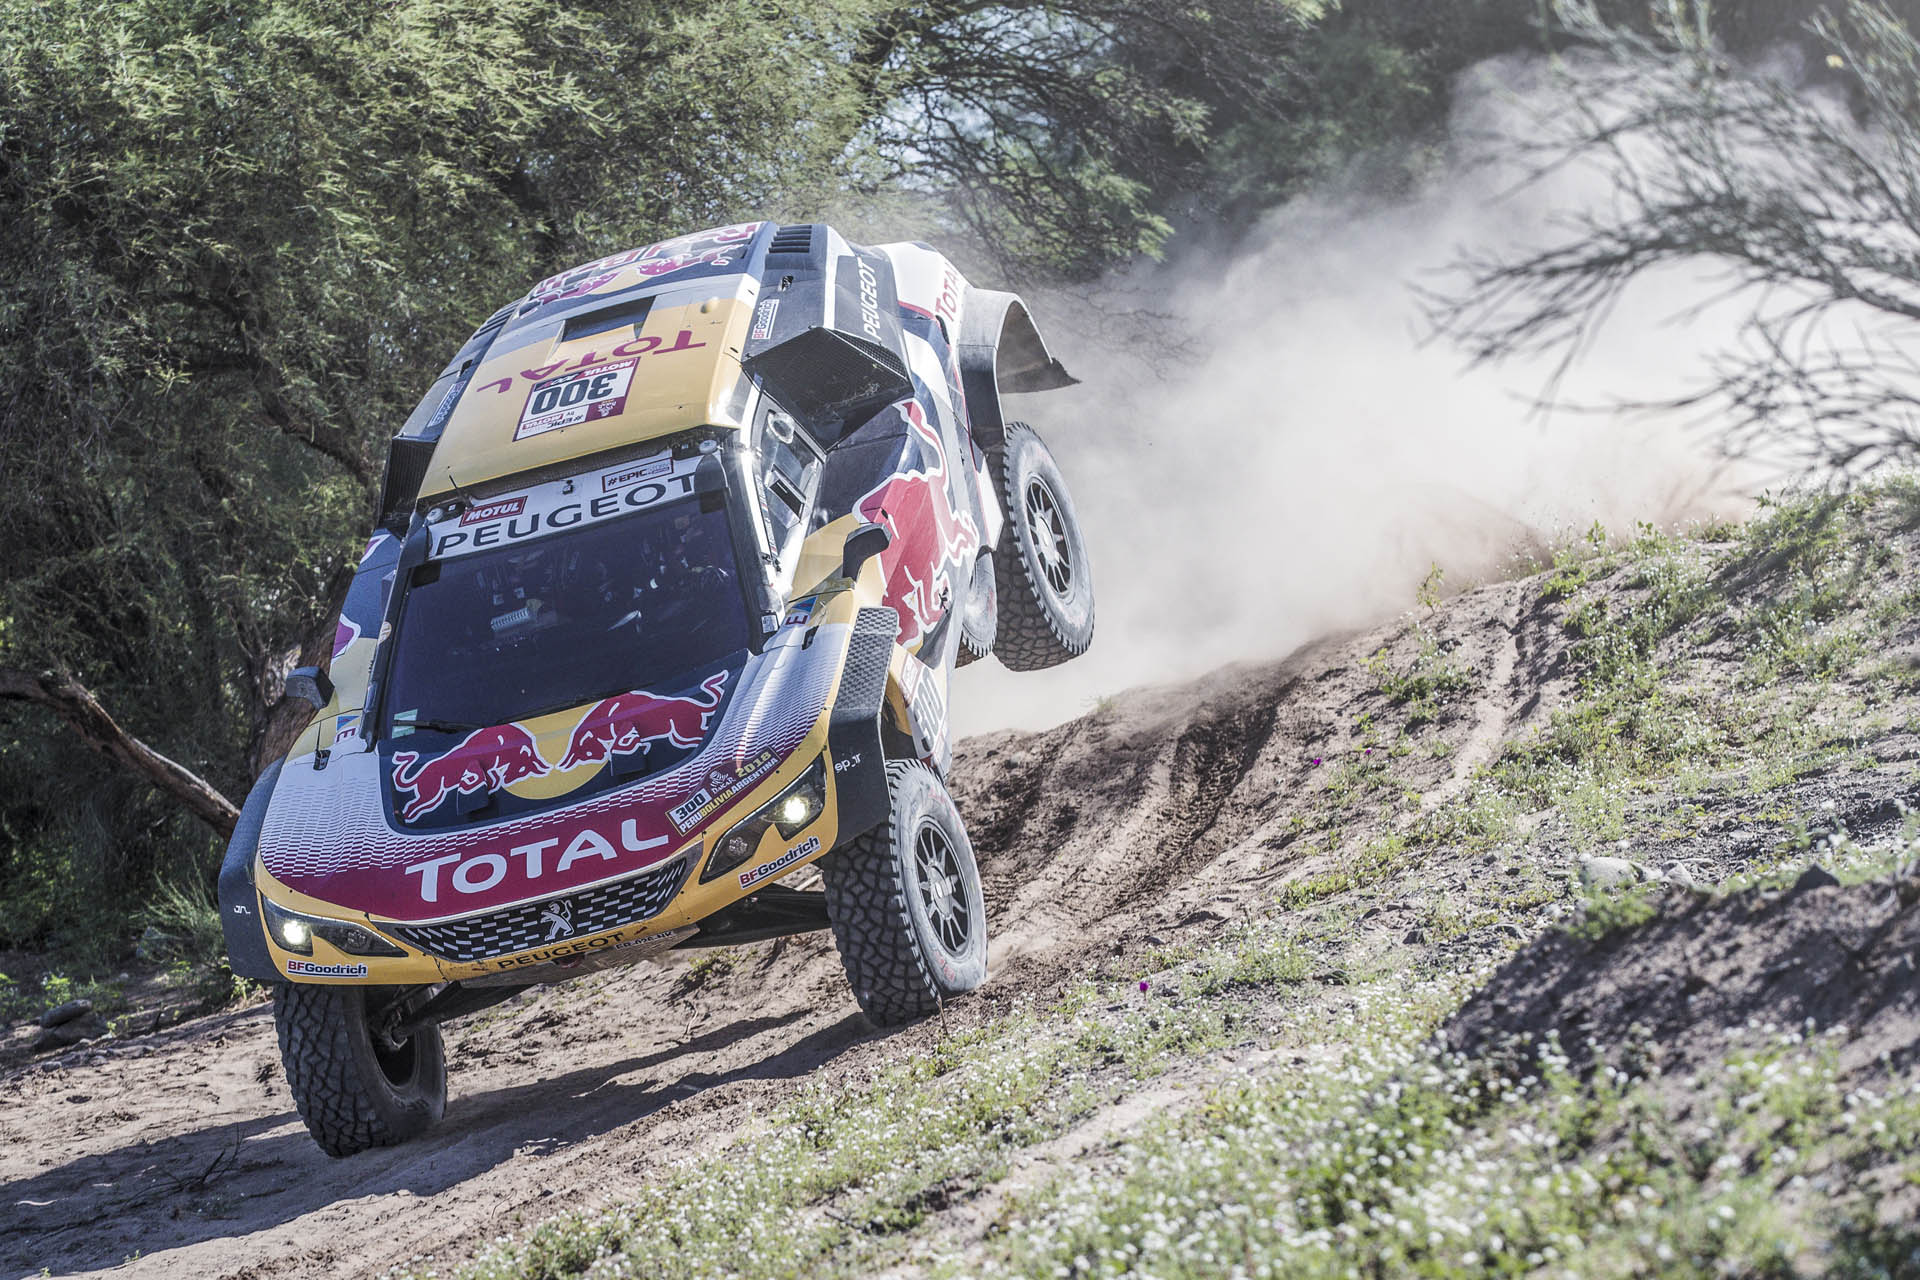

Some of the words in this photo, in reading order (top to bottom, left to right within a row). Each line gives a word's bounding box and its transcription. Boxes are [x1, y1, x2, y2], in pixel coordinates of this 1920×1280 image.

[857, 255, 881, 341] PEUGEOT
[476, 330, 707, 394] TOTAL
[531, 372, 618, 416] 300
[435, 472, 696, 557] PEUGEOT
[467, 501, 521, 521] MOTUL
[710, 776, 737, 795] DAKAR
[735, 751, 772, 778] 2018
[675, 793, 707, 820] 300
[679, 812, 703, 833] PERU
[700, 789, 734, 818] BOLIVIA
[731, 757, 779, 795] ARGENTINA
[404, 817, 669, 903] TOTAL
[739, 837, 820, 885] BFGoodrich
[287, 960, 367, 975] BFGoodrich
[498, 931, 625, 969] PEUGEOT
